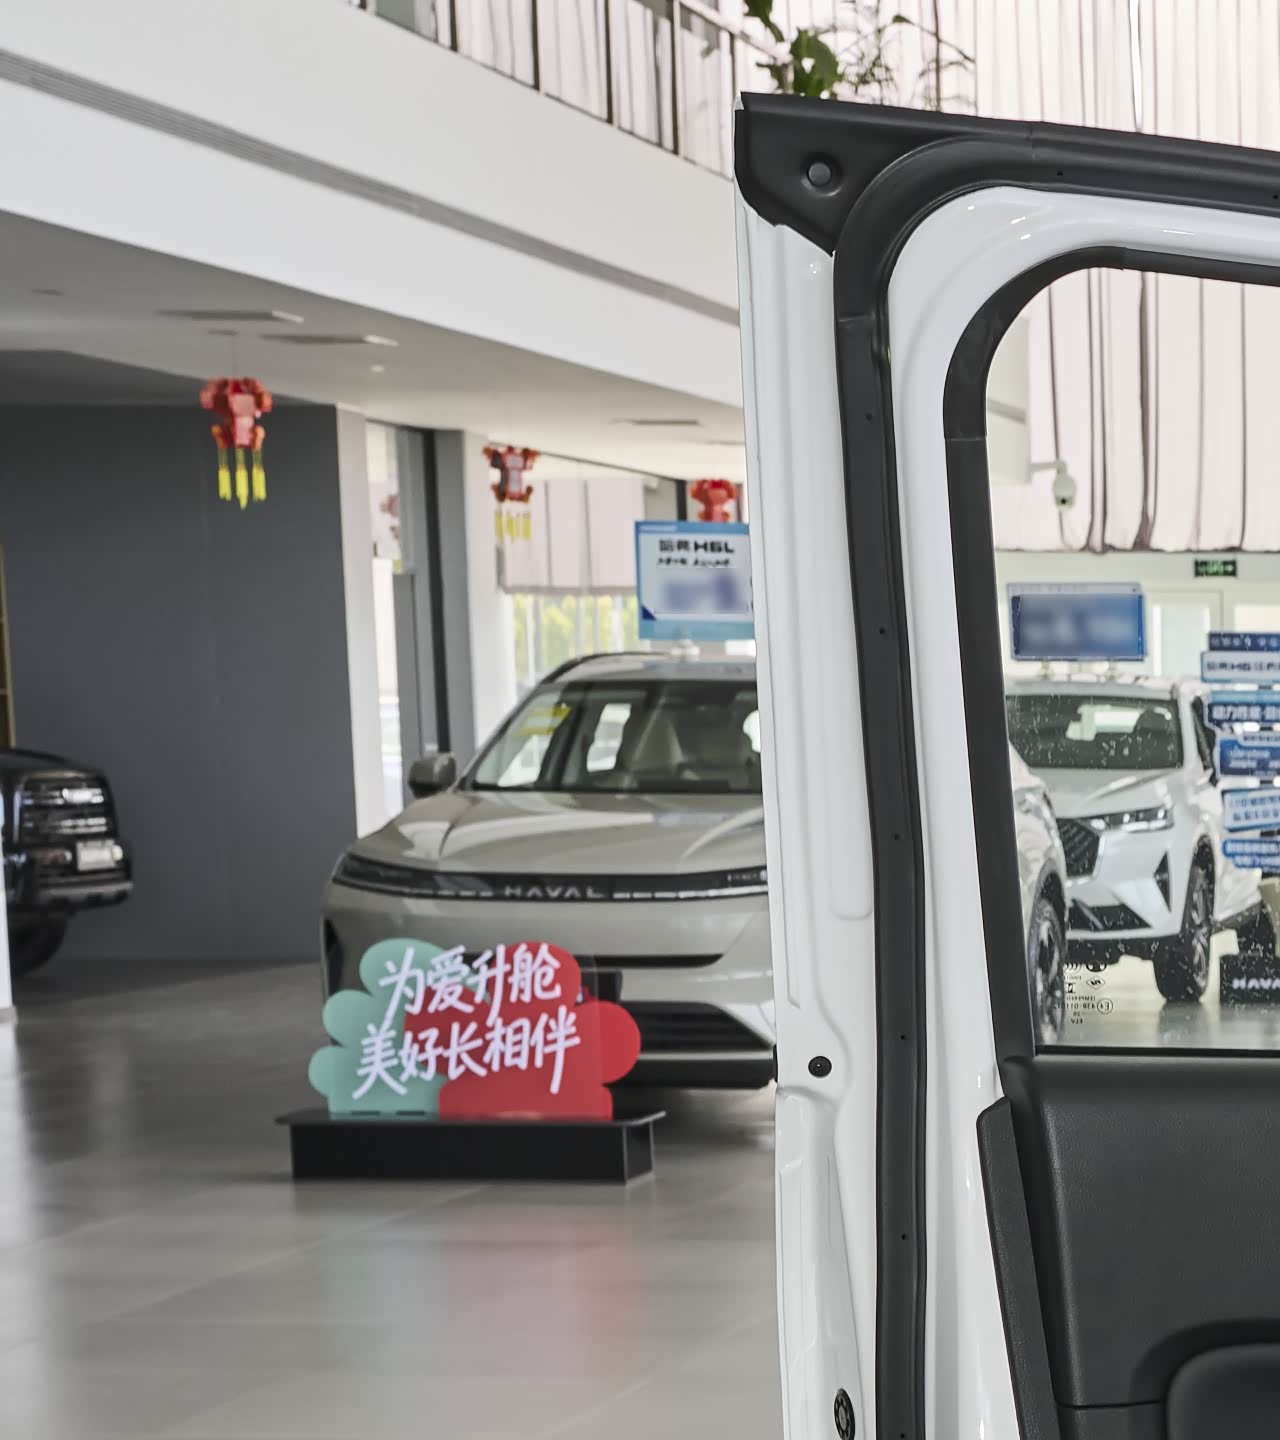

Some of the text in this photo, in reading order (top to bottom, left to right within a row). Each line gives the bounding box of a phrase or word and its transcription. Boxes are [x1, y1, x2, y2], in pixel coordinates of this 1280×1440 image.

[504, 885, 604, 898] HAVAL
[379, 943, 563, 1032] 为爱升舱
[353, 1005, 581, 1100] 美好长相伴
